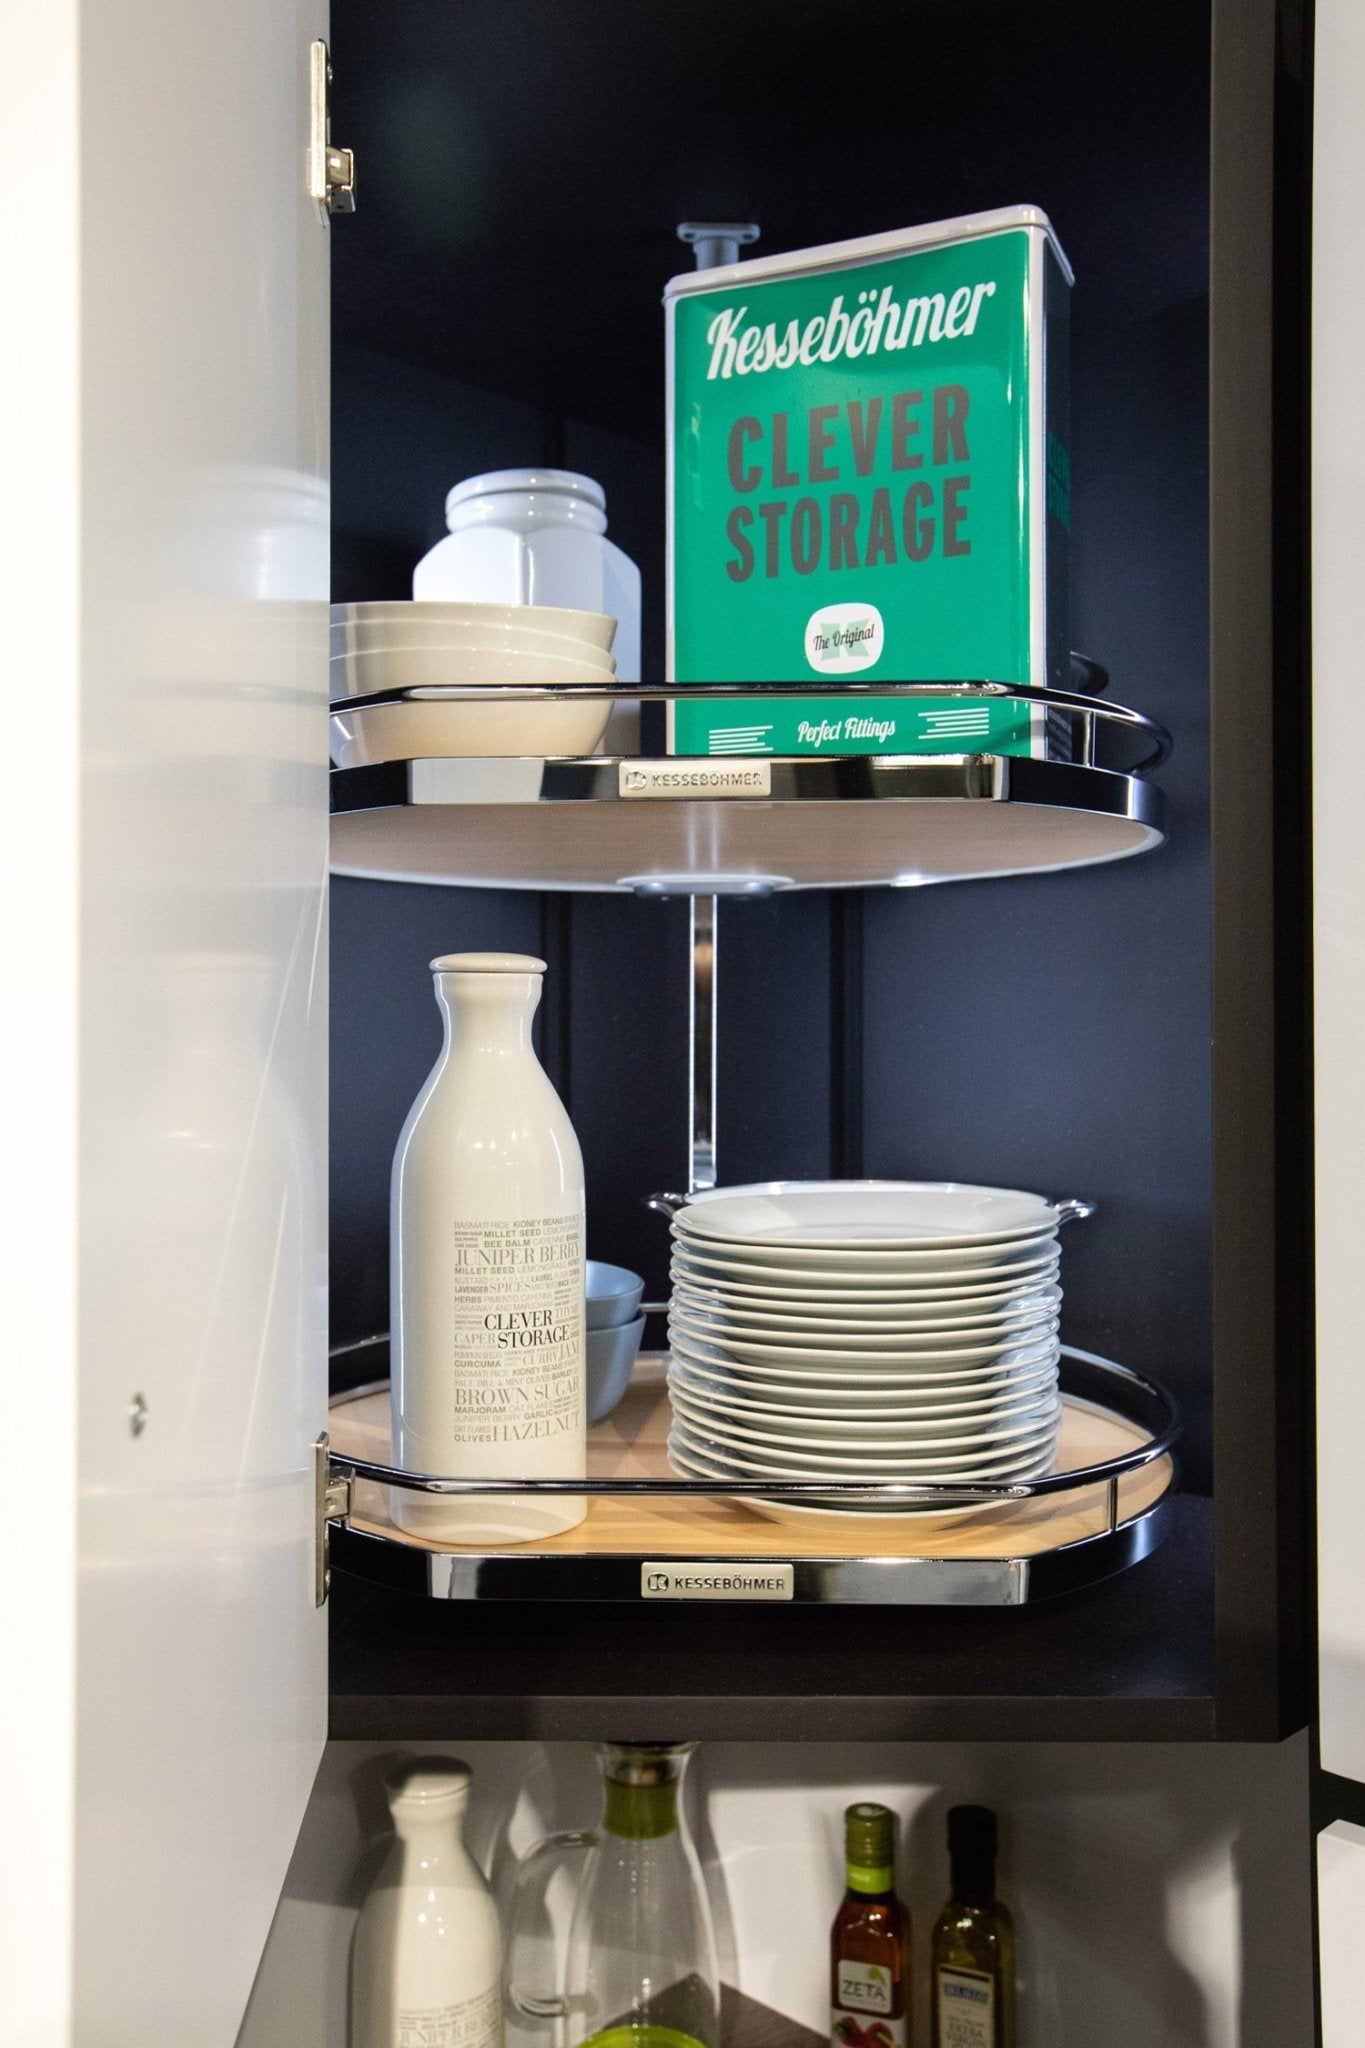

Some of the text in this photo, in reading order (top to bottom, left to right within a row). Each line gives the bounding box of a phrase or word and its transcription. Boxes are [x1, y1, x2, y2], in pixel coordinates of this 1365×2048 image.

[706, 280, 997, 380] Kesseböhmer
[727, 383, 971, 495] CLEVER
[726, 475, 972, 583] STORAGE
[813, 623, 875, 651] The Original
[798, 717, 896, 748] Perfect Fittings
[484, 1230, 516, 1238] MILLET
[519, 1229, 541, 1237] SEED
[513, 1219, 541, 1228] KIDNEY
[454, 1241, 579, 1266] JUNIPER BERRY
[484, 1240, 502, 1248] BEE
[505, 1239, 530, 1248] BALM
[484, 1309, 553, 1330] CLEVER
[498, 1324, 570, 1349] STORAGE
[454, 1360, 502, 1368] CURCUMA
[513, 1367, 541, 1376] KIDNEY
[455, 1376, 579, 1405] BROWN SUGAR
[454, 1406, 506, 1414] MARJORAM
[524, 1408, 553, 1420] GARLIC
[494, 1410, 580, 1442] HAZELNUT
[454, 1434, 491, 1442] OLIVES
[675, 1574, 785, 1590] KESSEBÖHMER
[843, 1979, 887, 2001] ZETA
